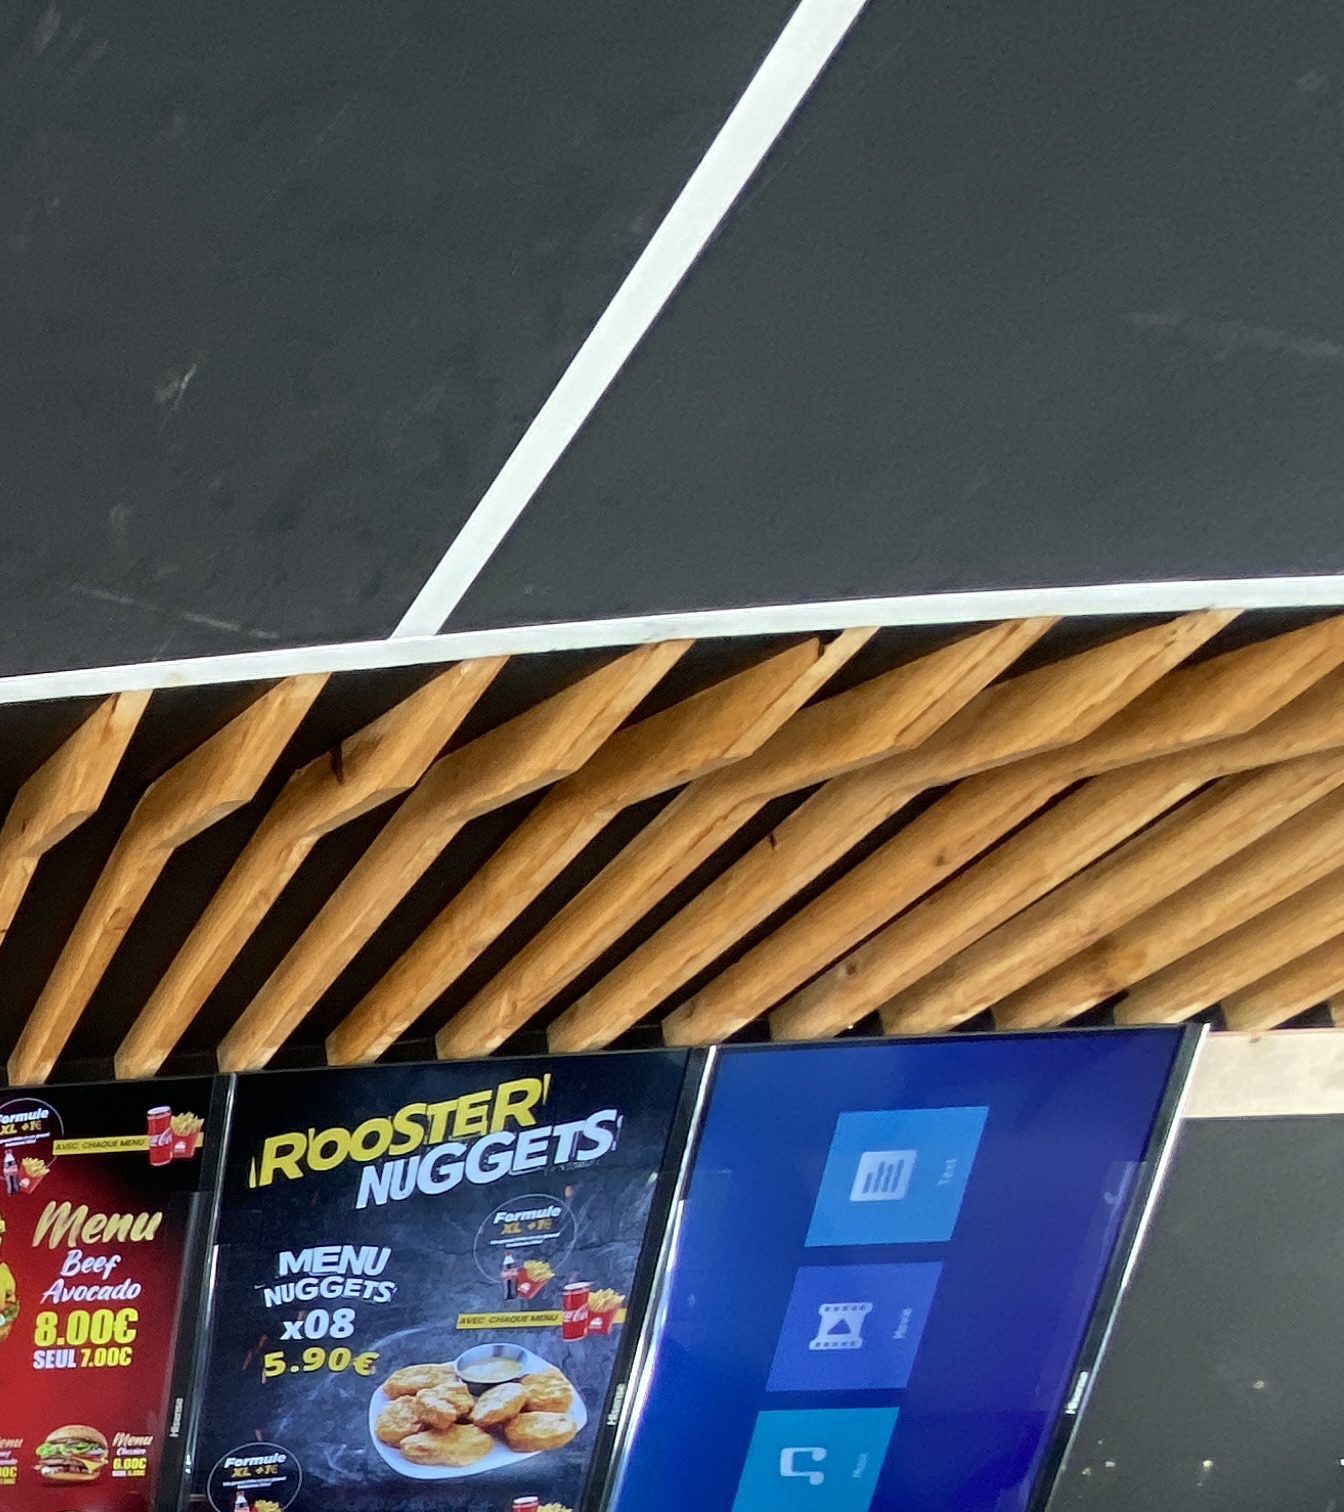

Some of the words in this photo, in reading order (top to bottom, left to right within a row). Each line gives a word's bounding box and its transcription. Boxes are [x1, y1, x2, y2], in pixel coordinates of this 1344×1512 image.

[0, 1123, 17, 1136] XL
[255, 1073, 551, 1188] ROOSTER
[355, 1109, 621, 1209] NUGGETS
[31, 1200, 163, 1250] Menu
[494, 1205, 562, 1224] Formule
[59, 1249, 122, 1278] Beef
[278, 1245, 391, 1278] MENU
[40, 1278, 141, 1305] Avocado
[263, 1276, 396, 1308] NUGGETS
[34, 1308, 140, 1347] 8.00€
[281, 1308, 355, 1341] x08
[459, 1316, 485, 1324] AVEC
[488, 1315, 529, 1324] CHAQUE
[530, 1314, 559, 1322] MENU
[33, 1349, 77, 1370] SEUL
[80, 1347, 133, 1368] 7.00€
[262, 1346, 380, 1379] 5.90€
[112, 1432, 154, 1447] Menu
[224, 1452, 287, 1469] Formule
[231, 1467, 252, 1478] XL
